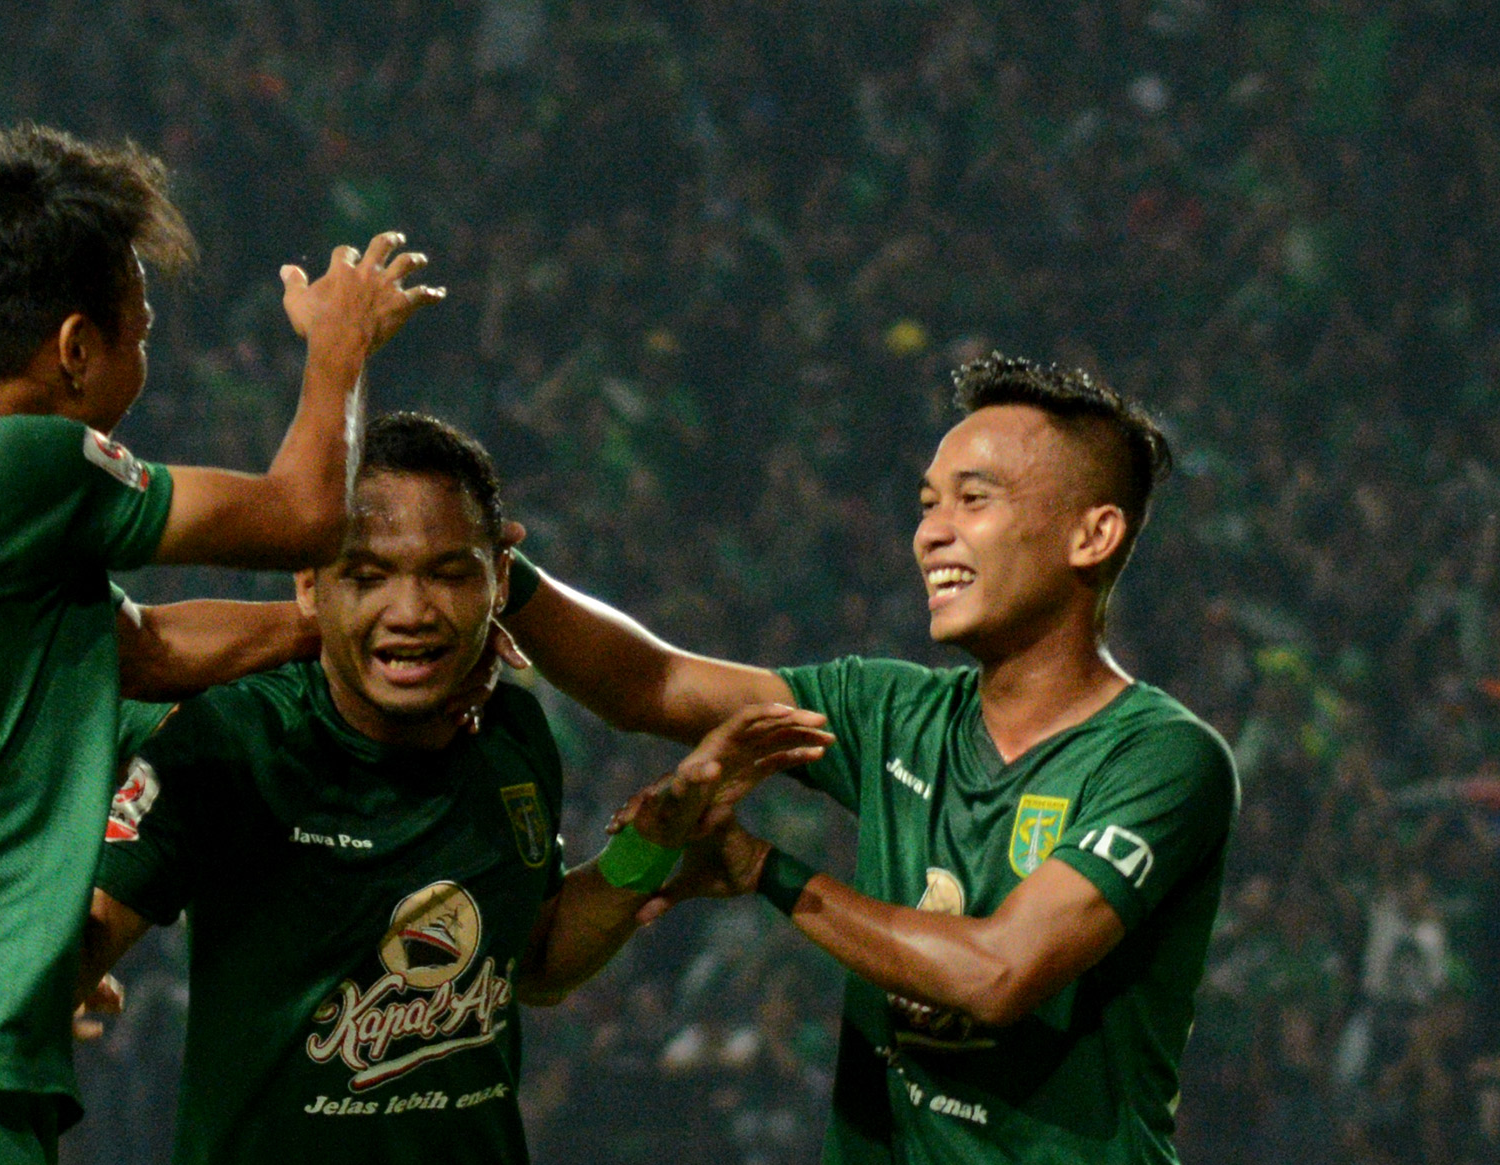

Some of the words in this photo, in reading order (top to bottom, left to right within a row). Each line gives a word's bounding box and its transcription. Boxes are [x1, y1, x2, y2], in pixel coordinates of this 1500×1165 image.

[886, 758, 924, 794] Jawa
[289, 827, 335, 847] Jawa
[338, 834, 373, 848] Pos
[306, 971, 453, 1072] Kapal
[304, 1094, 380, 1116] Jelas
[384, 1090, 449, 1115] lebih
[455, 1083, 512, 1109] enak
[929, 1094, 988, 1125] enak
